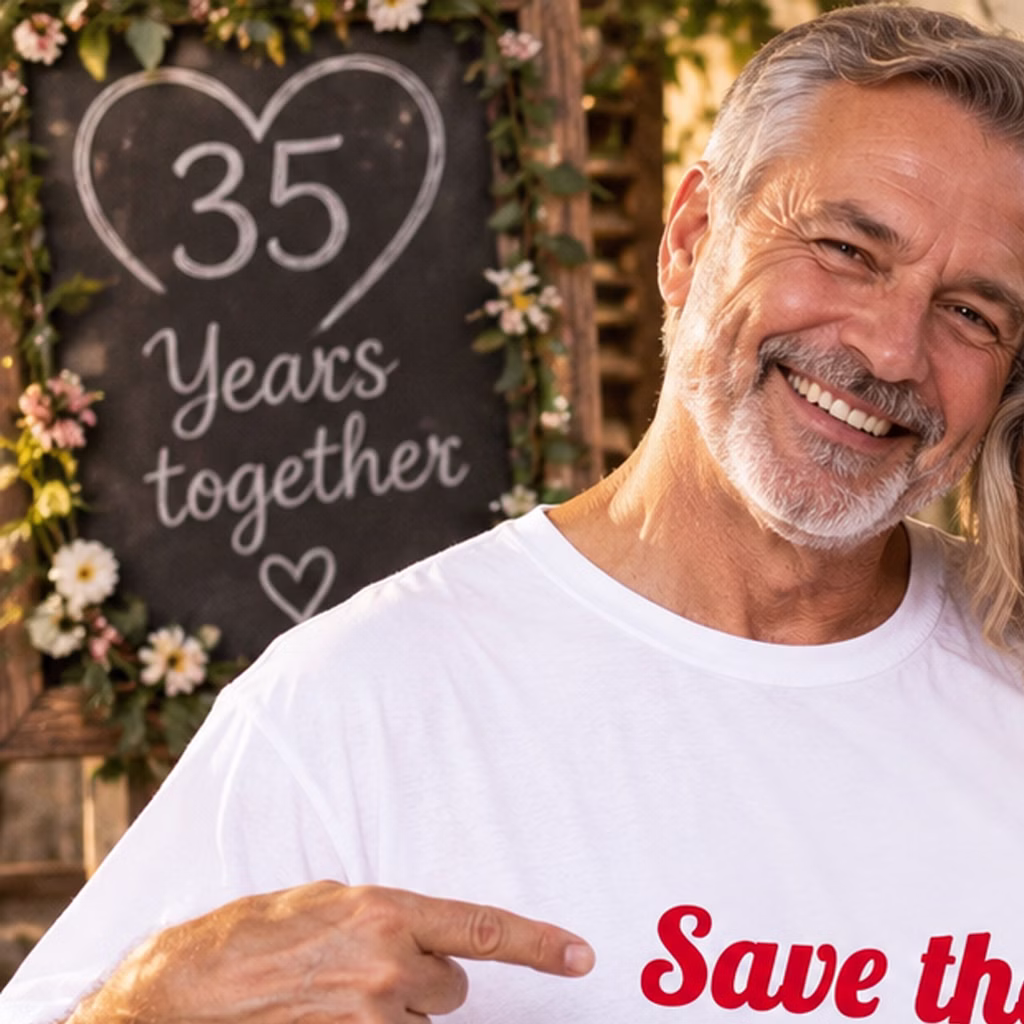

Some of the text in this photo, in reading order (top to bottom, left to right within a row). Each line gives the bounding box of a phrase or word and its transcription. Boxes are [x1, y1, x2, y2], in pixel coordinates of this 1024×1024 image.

[172, 134, 349, 280] 35
[141, 321, 399, 440] Years
[142, 411, 470, 556] together
[640, 904, 889, 1018] Save
